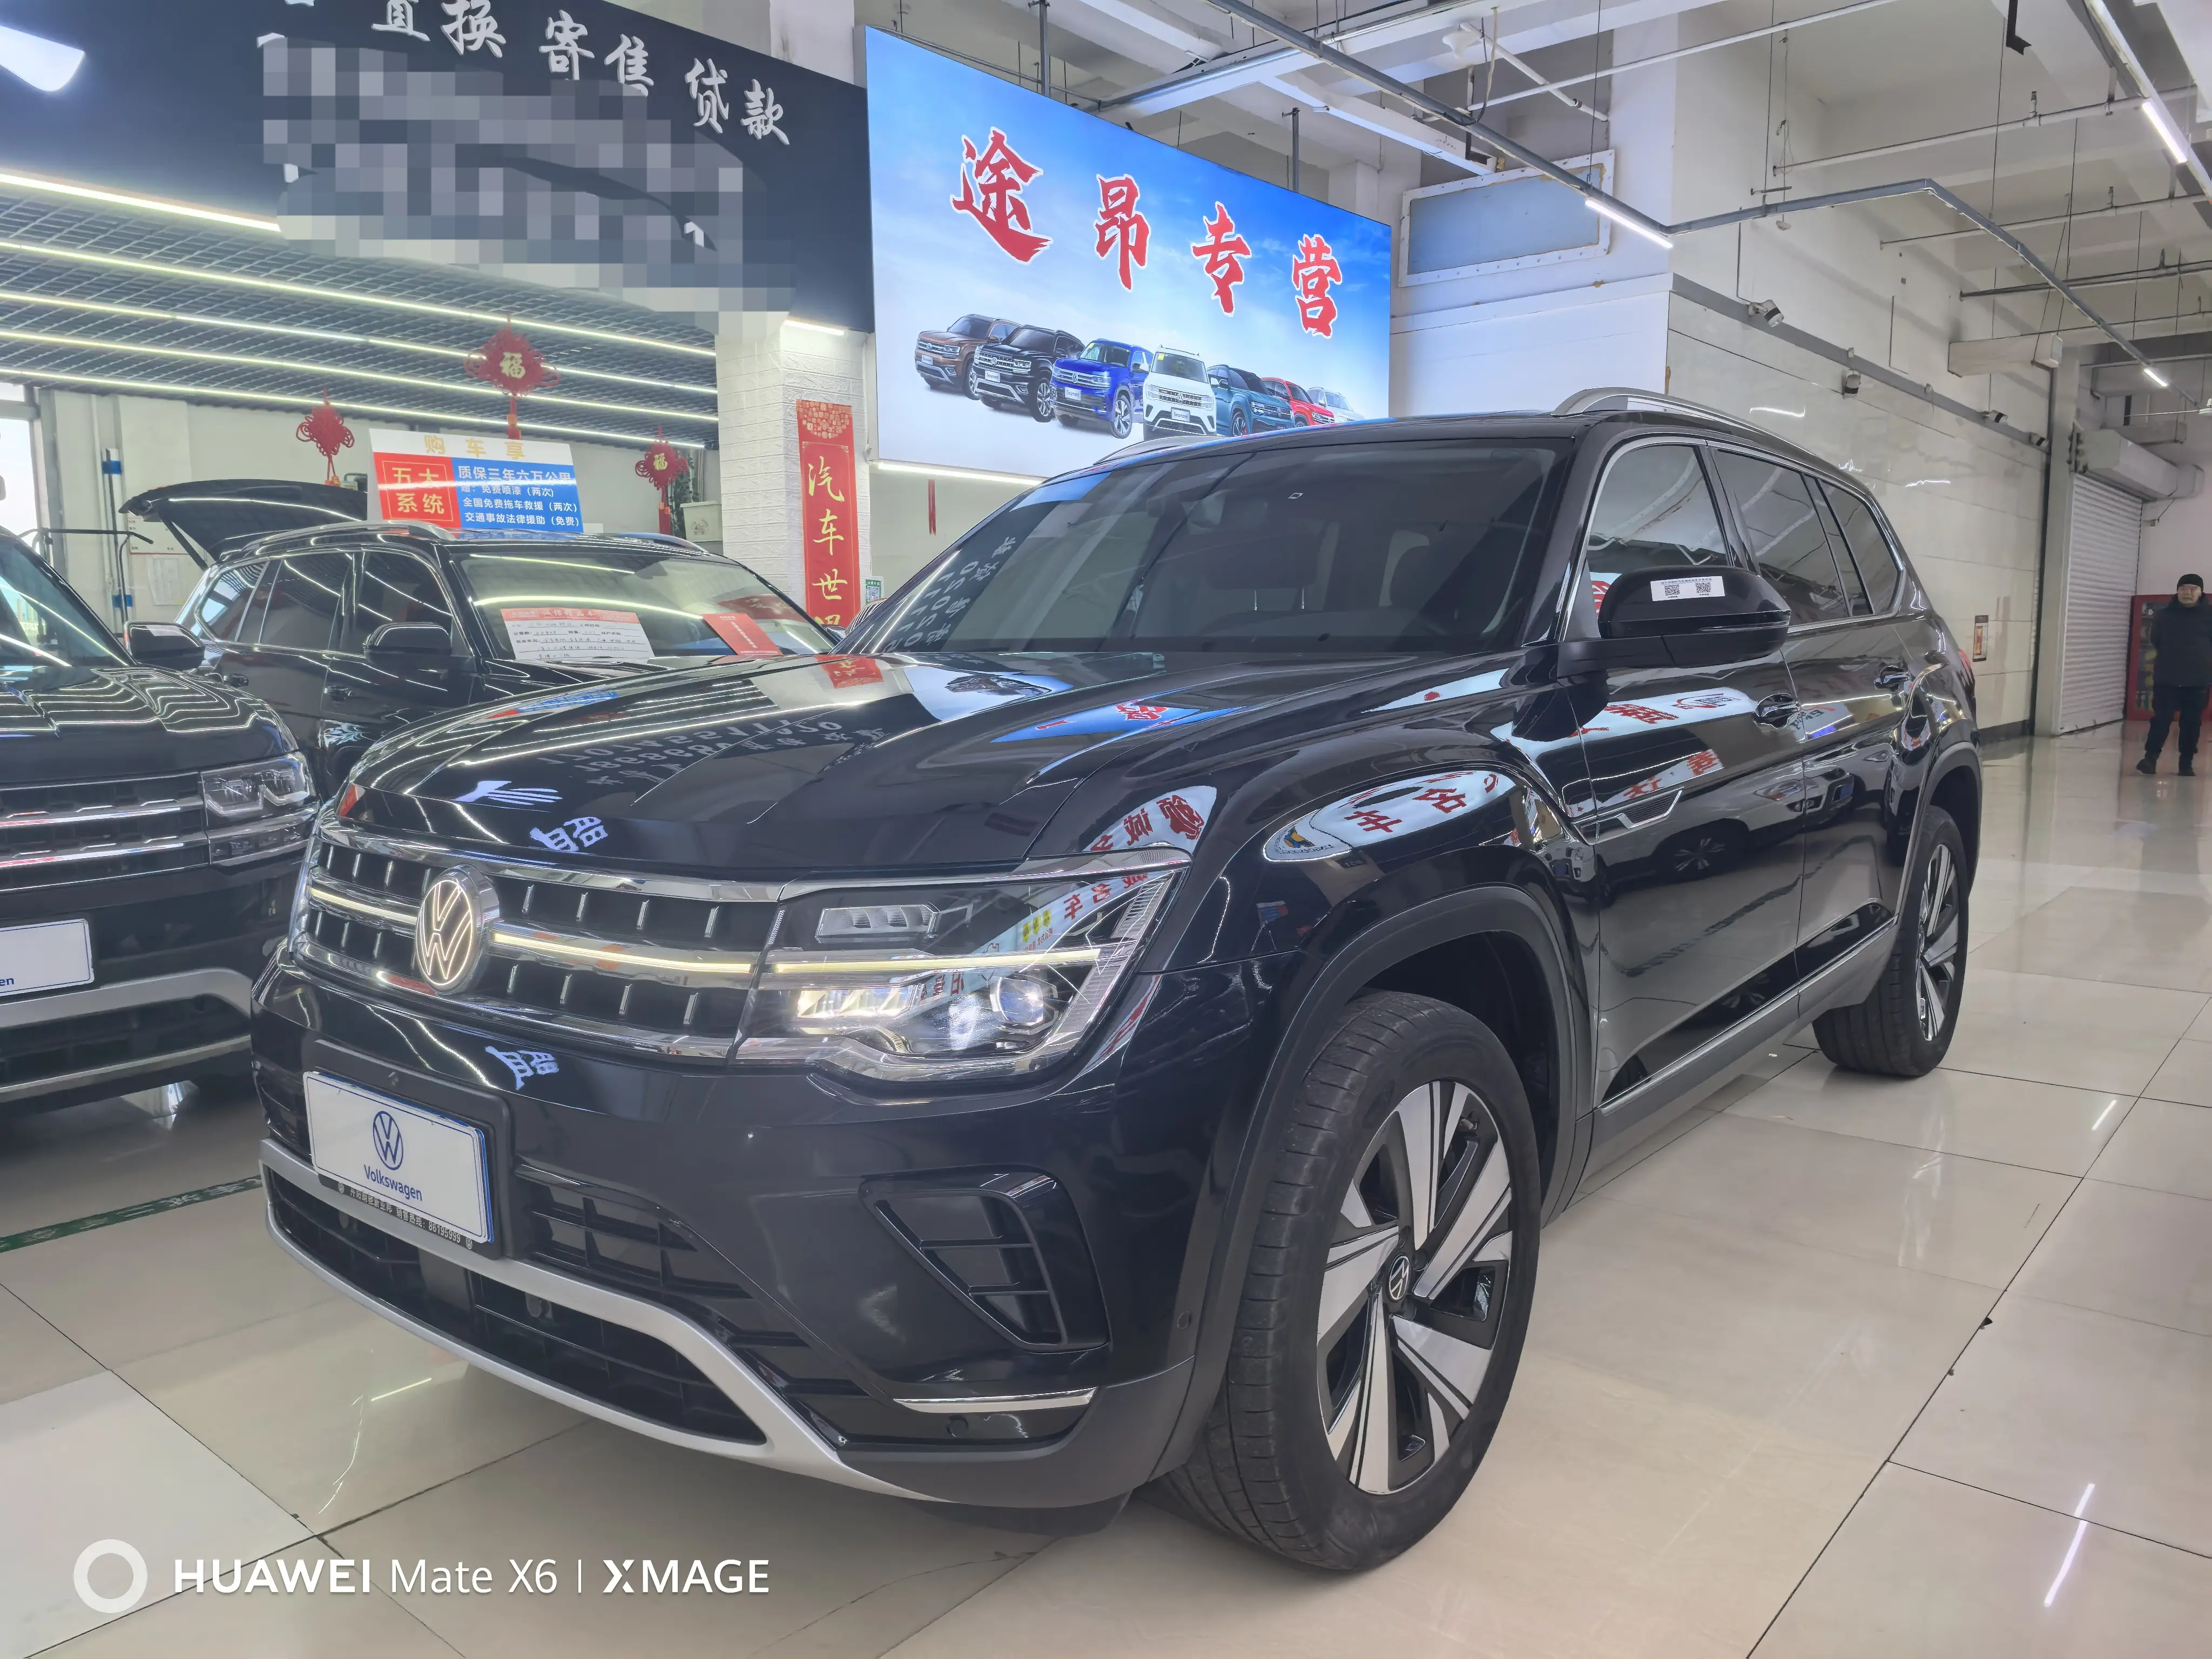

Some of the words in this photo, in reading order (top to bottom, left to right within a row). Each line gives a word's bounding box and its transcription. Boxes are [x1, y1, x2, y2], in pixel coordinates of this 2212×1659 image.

[685, 58, 790, 145] 贷款
[950, 126, 1343, 339] 途昂专营
[500, 352, 525, 379] 福
[424, 434, 526, 461] 购车享
[392, 467, 439, 485] 五大
[395, 493, 444, 515] 系统
[364, 1164, 422, 1202] Volkswagen
